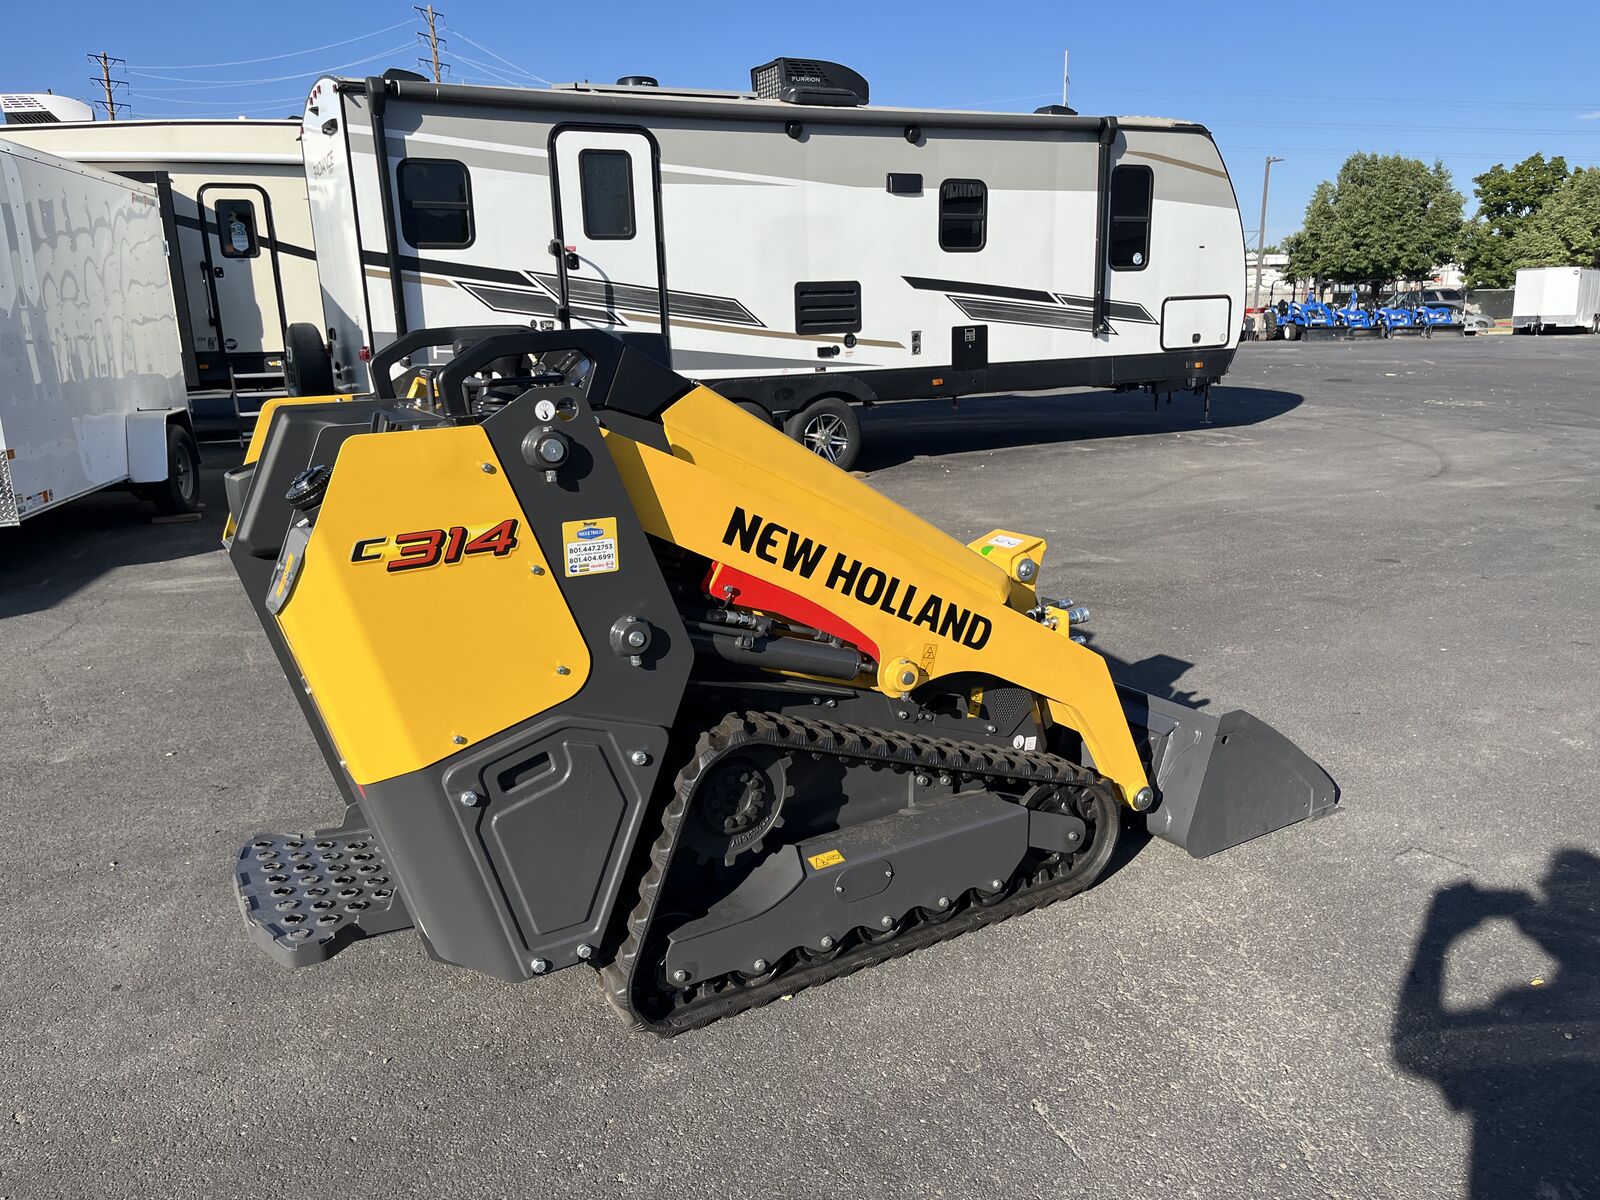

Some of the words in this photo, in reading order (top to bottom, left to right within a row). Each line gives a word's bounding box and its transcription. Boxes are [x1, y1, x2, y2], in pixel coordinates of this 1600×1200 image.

[791, 75, 821, 83] FURRION
[569, 544, 612, 554] 801.447.2753
[569, 554, 614, 564] 801.404.6991
[722, 506, 828, 580] NEW
[824, 552, 993, 651] HOLLAND
